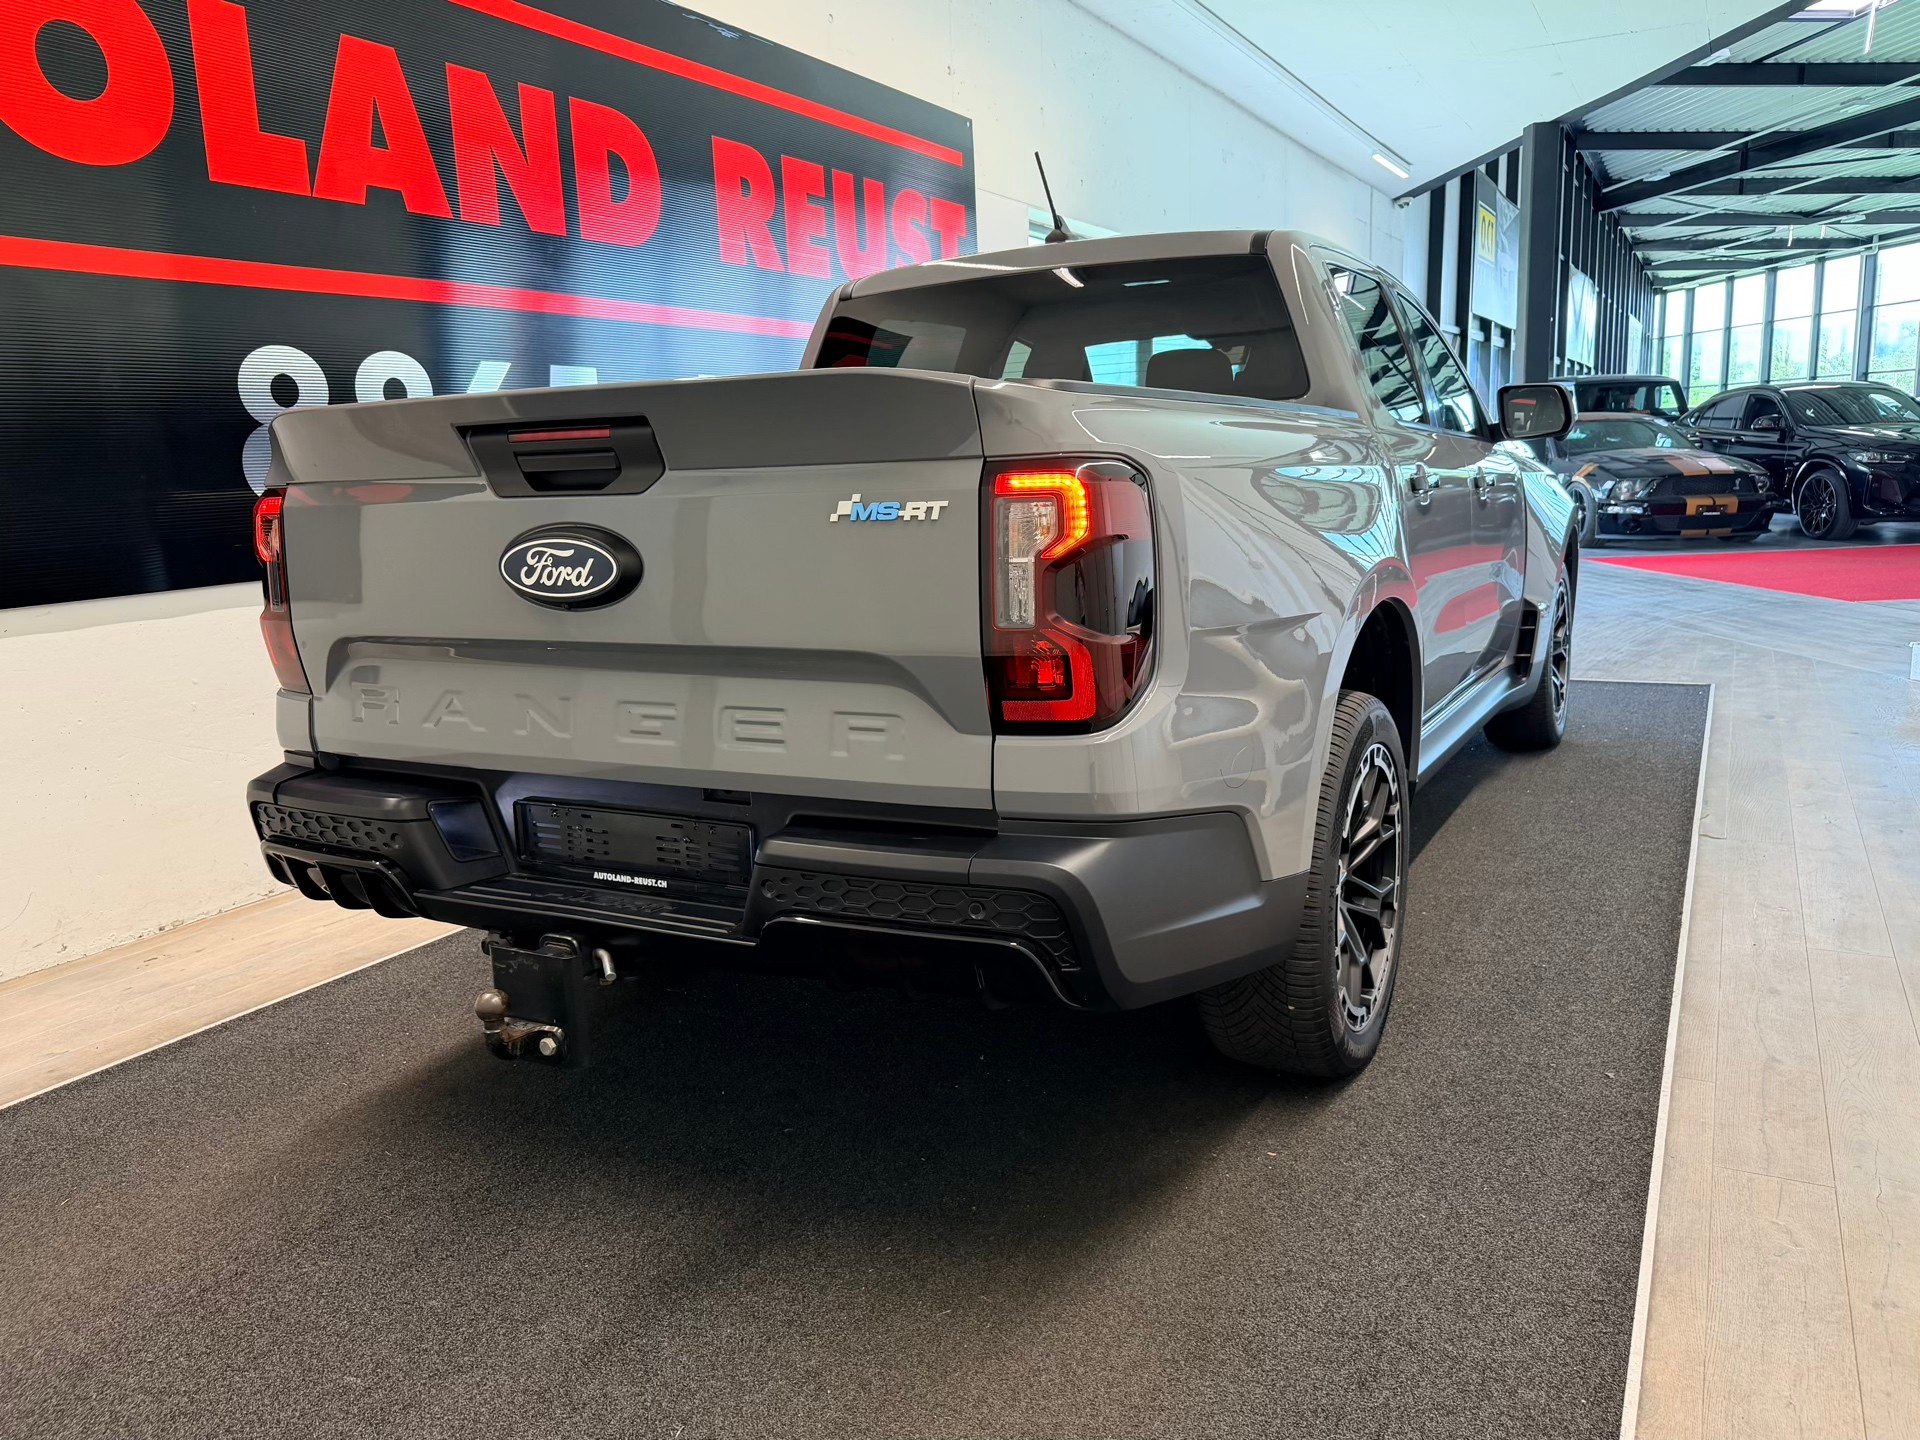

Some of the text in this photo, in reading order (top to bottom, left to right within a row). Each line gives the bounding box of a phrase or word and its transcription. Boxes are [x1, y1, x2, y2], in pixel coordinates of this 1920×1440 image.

[711, 135, 967, 281] REUST
[849, 500, 949, 521] MS-RT
[520, 546, 594, 587] Ford
[351, 682, 906, 758] RANGER
[593, 871, 668, 889] AUTOLAND-REUST.CH
